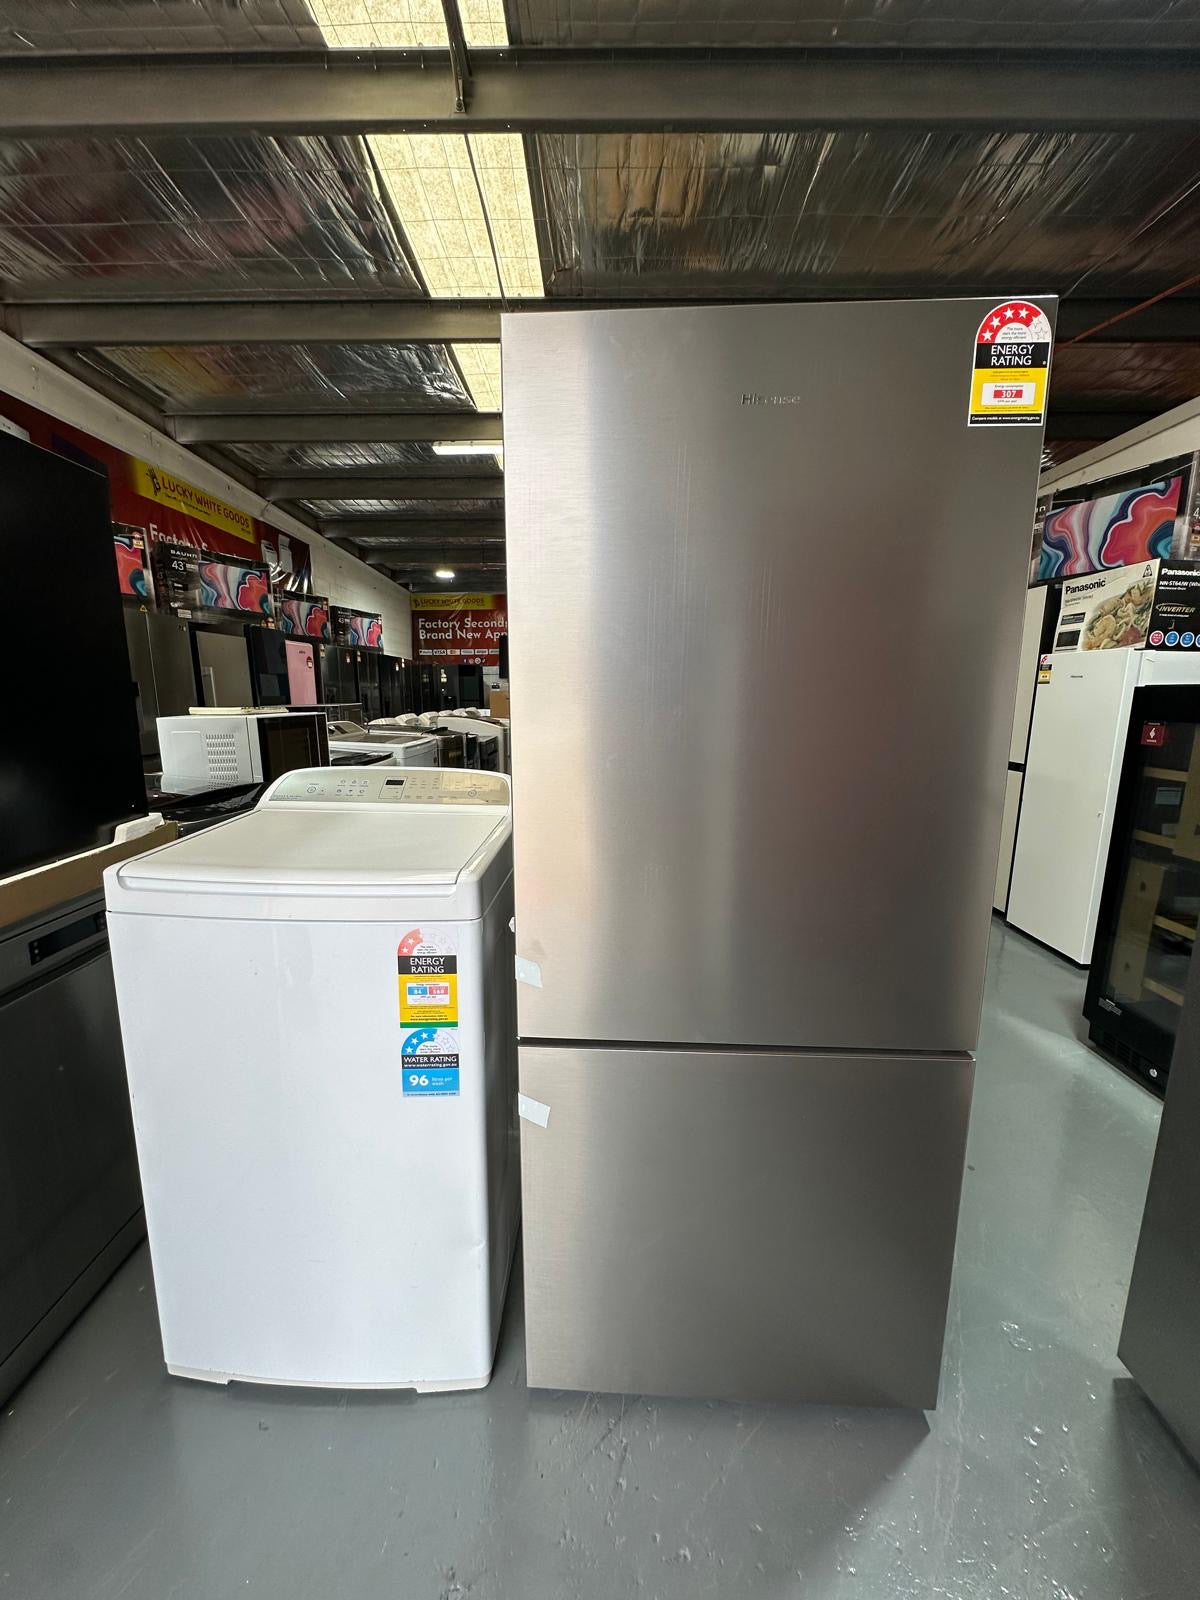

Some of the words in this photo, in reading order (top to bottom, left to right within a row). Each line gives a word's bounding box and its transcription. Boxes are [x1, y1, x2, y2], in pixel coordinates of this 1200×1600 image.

[991, 344, 1035, 355] ENERGY
[991, 356, 1032, 366] RATING
[1001, 390, 1016, 398] 307
[161, 476, 193, 501] LUCKY
[194, 493, 222, 515] WHITE
[222, 507, 250, 529] GOODS
[1161, 568, 1200, 577] Panasonic
[1065, 578, 1106, 595] Panasonic
[419, 618, 460, 631] Factory
[419, 629, 453, 640] Brand
[456, 629, 482, 639] New
[410, 957, 445, 966] ENERGY
[411, 965, 445, 974] RATING
[409, 1074, 429, 1086] 96
